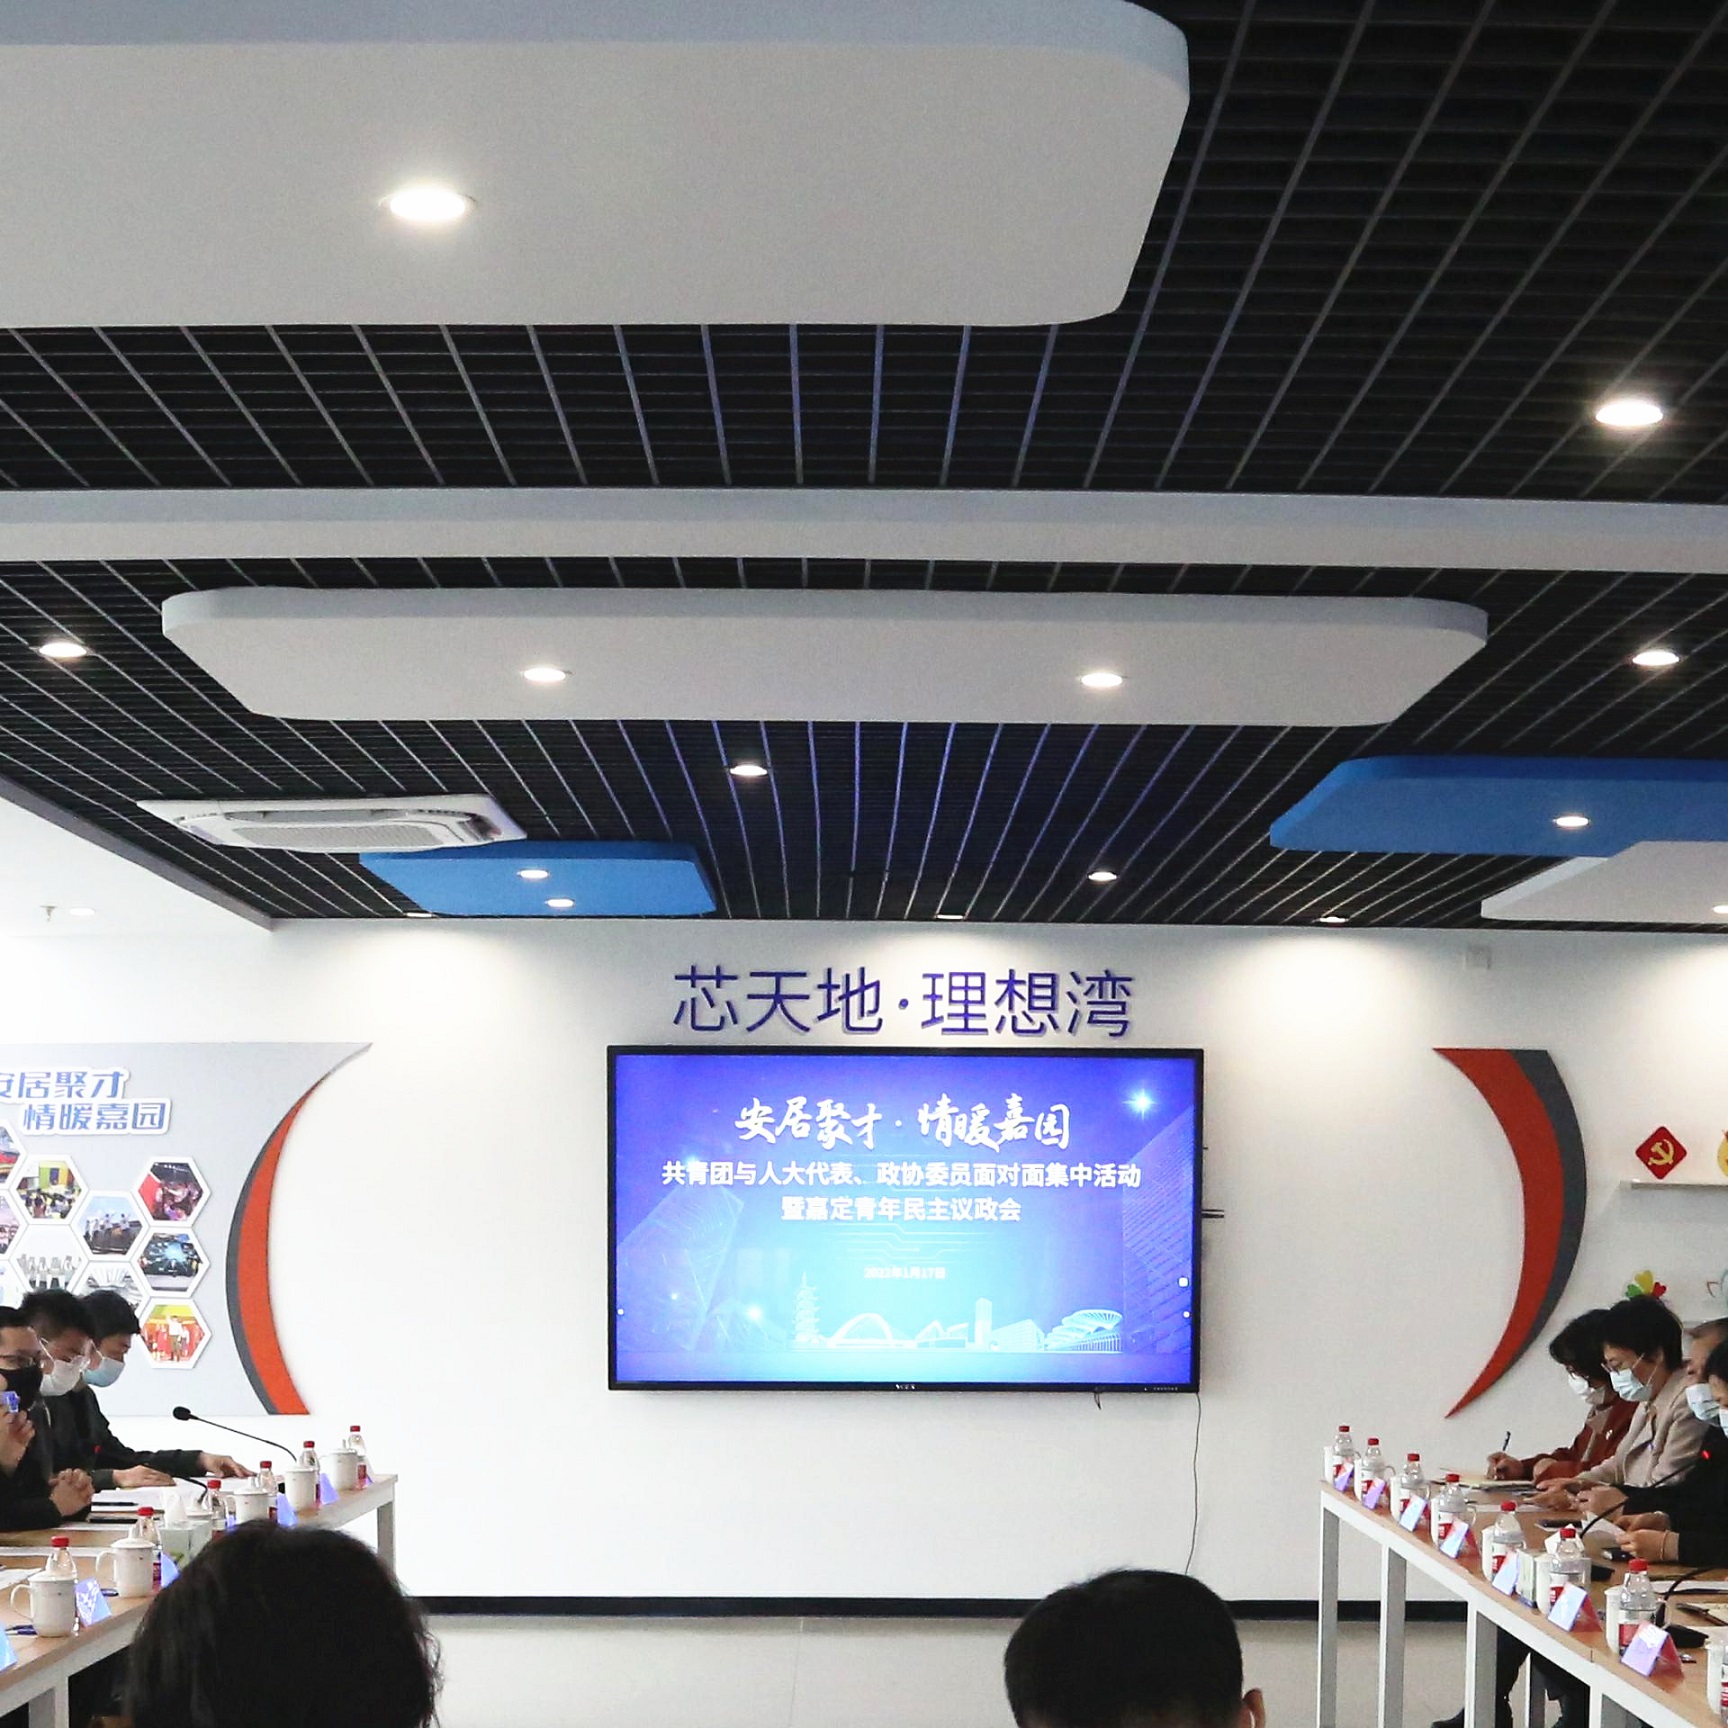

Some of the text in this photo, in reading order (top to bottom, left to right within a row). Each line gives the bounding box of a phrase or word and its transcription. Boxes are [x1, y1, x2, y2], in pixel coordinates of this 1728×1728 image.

[673, 965, 1134, 1037] 芯天地·理想湾
[23, 1102, 167, 1132] 情暖嘉园
[735, 1092, 1071, 1152] 安居聚才·情暖嘉园
[662, 1160, 1142, 1189] 共青团与人大代表、政协委员面对面集中活动
[781, 1196, 1022, 1222] 暨嘉定青年民主议政会
